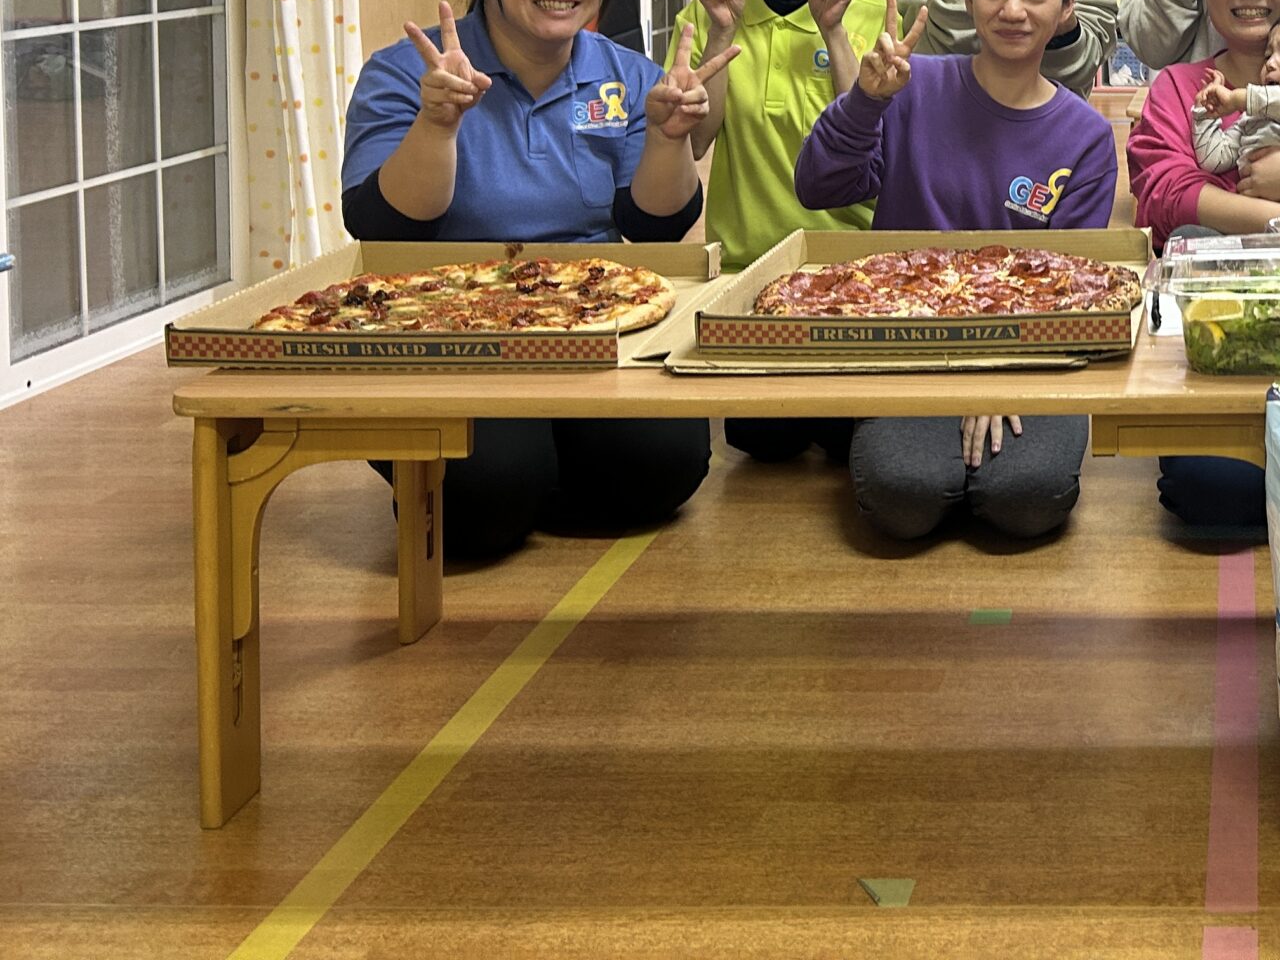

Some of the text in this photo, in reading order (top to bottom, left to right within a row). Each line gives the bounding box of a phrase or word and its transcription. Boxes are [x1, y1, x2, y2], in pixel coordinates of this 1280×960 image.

[812, 326, 1018, 340] FRESH BAKED PIZZA
[285, 342, 498, 356] FRESH BAKED PIZZA
